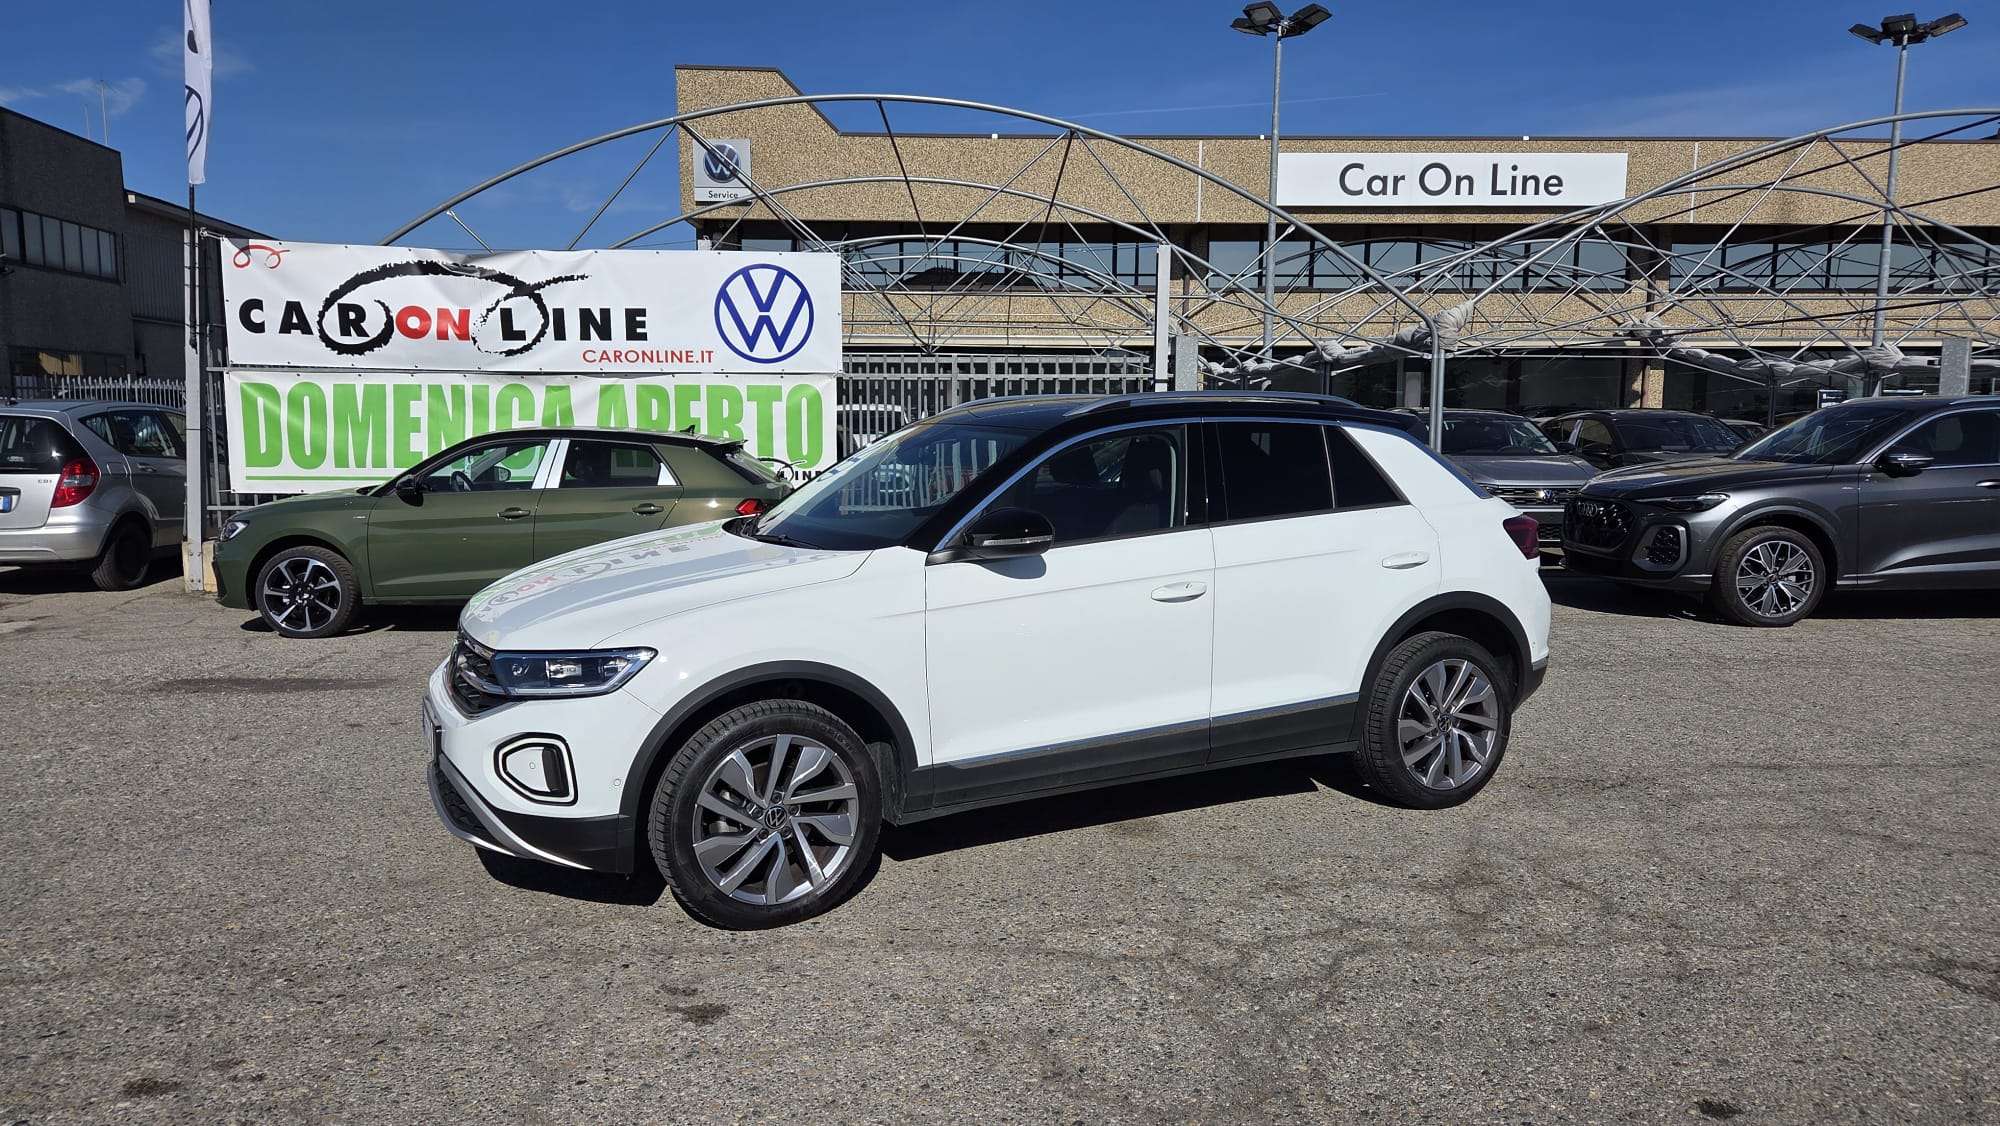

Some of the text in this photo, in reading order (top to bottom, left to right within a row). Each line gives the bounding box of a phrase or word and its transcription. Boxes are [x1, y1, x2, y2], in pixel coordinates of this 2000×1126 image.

[1338, 162, 1564, 197] Car On Line
[708, 190, 739, 199] Service
[582, 348, 715, 364] CARONLINE.IT
